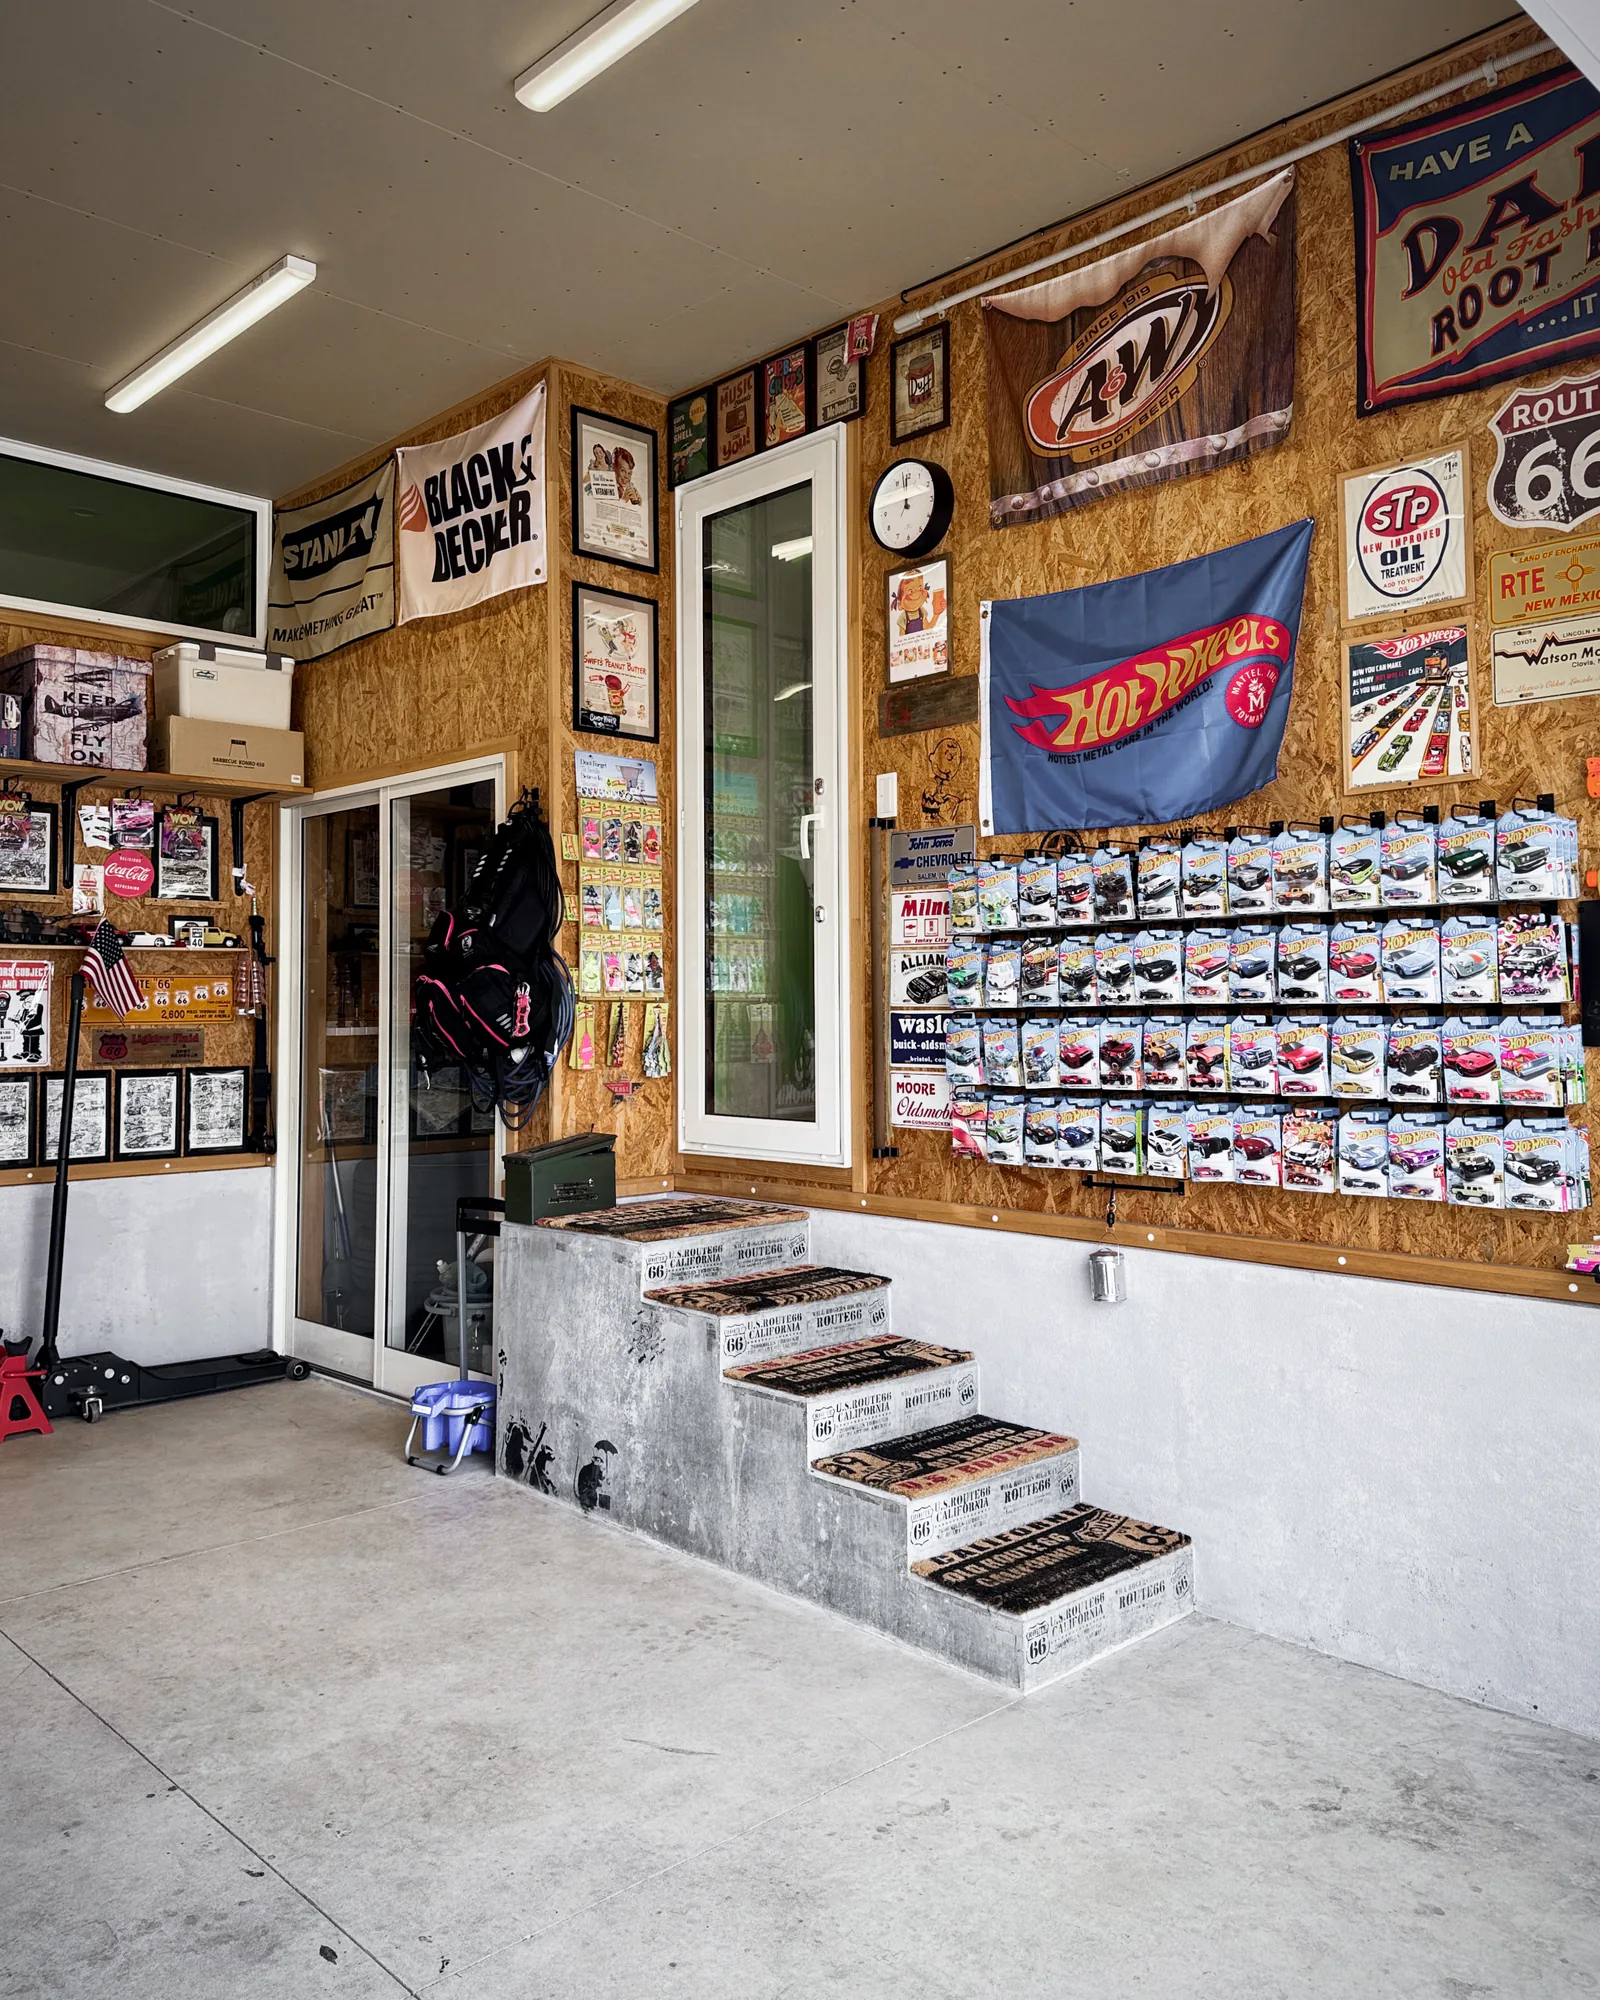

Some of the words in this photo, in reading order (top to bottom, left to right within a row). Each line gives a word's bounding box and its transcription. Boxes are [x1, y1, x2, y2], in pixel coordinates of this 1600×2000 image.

[1389, 134, 1491, 180] HAVE
[1505, 122, 1534, 151] A
[1442, 249, 1498, 295] Old
[1430, 244, 1562, 357] ROOT
[1075, 308, 1119, 352] SINCE
[1122, 284, 1151, 311] 1919
[720, 373, 753, 412] MUSIC
[911, 373, 932, 397] Duff
[1089, 426, 1132, 456] ROOT
[1138, 385, 1181, 424] BEER
[673, 428, 693, 444] SHELL
[424, 441, 515, 527] BLACK
[1371, 488, 1431, 533] STP
[431, 489, 532, 582] DECKER
[1363, 542, 1383, 555] NEW
[1390, 527, 1441, 549] IMPROVED
[1380, 544, 1426, 566] OIL
[1519, 555, 1540, 563] LAND
[1542, 551, 1554, 559] OF
[1380, 560, 1426, 579] TREATMENT
[1383, 579, 1397, 589] ADD
[1397, 577, 1406, 586] TO
[1406, 575, 1425, 584] YOUR
[1398, 585, 1410, 593] OIL
[1501, 566, 1546, 601] RTE
[1524, 597, 1556, 613] NEW
[1513, 638, 1537, 647] TOYOTA
[1562, 628, 1591, 639] LINCOLN
[604, 658, 626, 671] PEANUT
[626, 661, 646, 675] BUTTER
[1523, 648, 1577, 667] Watson
[1352, 679, 1360, 687] AS
[1359, 676, 1374, 686] MANY
[1408, 666, 1424, 677] CARS
[1364, 666, 1376, 675] YOU
[1375, 664, 1387, 673] CAN
[1386, 660, 1402, 670] MAKE
[63, 691, 116, 706] KEEP
[1352, 689, 1360, 697] AS
[1360, 686, 1371, 695] YOU
[1047, 752, 1081, 766] HOTTEST
[1083, 743, 1114, 762] METAL
[1115, 732, 1141, 751] CARS
[1142, 722, 1154, 737] IN
[1155, 709, 1175, 728] THE
[1172, 678, 1214, 718] WORLD!
[71, 733, 106, 748] FLY
[70, 749, 104, 763] ON
[212, 757, 237, 765] BARBECUE
[909, 836, 929, 851] John
[930, 834, 955, 849] Jones
[916, 851, 973, 868] CHEVROLET
[105, 862, 152, 882] Coca-Cola
[918, 872, 938, 880] SALEM,
[192, 938, 203, 947] 40
[901, 953, 947, 973] ALLIAN
[2, 980, 17, 989] AND
[161, 1009, 185, 1020] 2,600
[105, 1046, 122, 1057] 66
[896, 1081, 936, 1096] MOORE
[738, 1243, 783, 1260] ROUTE66
[792, 1242, 806, 1257] 66
[670, 1254, 721, 1268] CALIFORNIA
[648, 1266, 665, 1279] 66
[816, 1309, 862, 1328] ROUTE66
[872, 1309, 885, 1324] 66
[749, 1322, 800, 1339] CALIFORNIA
[726, 1337, 743, 1351] 66
[905, 1387, 951, 1409] ROUTE66
[961, 1385, 974, 1402] 66
[837, 1402, 890, 1423] CALIFORNIA
[815, 1419, 832, 1438] 66
[1004, 1477, 1051, 1504] ROUTE66
[1060, 1474, 1074, 1494] 66
[936, 1498, 989, 1523] CALIFORNIA
[913, 1521, 931, 1541] 66
[929, 1503, 1096, 1567] CALIFORNIA
[1085, 1511, 1123, 1541] ROUTE
[1119, 1580, 1166, 1609] ROUTE66
[1175, 1575, 1188, 1596] 66
[1051, 1604, 1104, 1637] CALIFORNIA
[1029, 1637, 1047, 1660] 66
